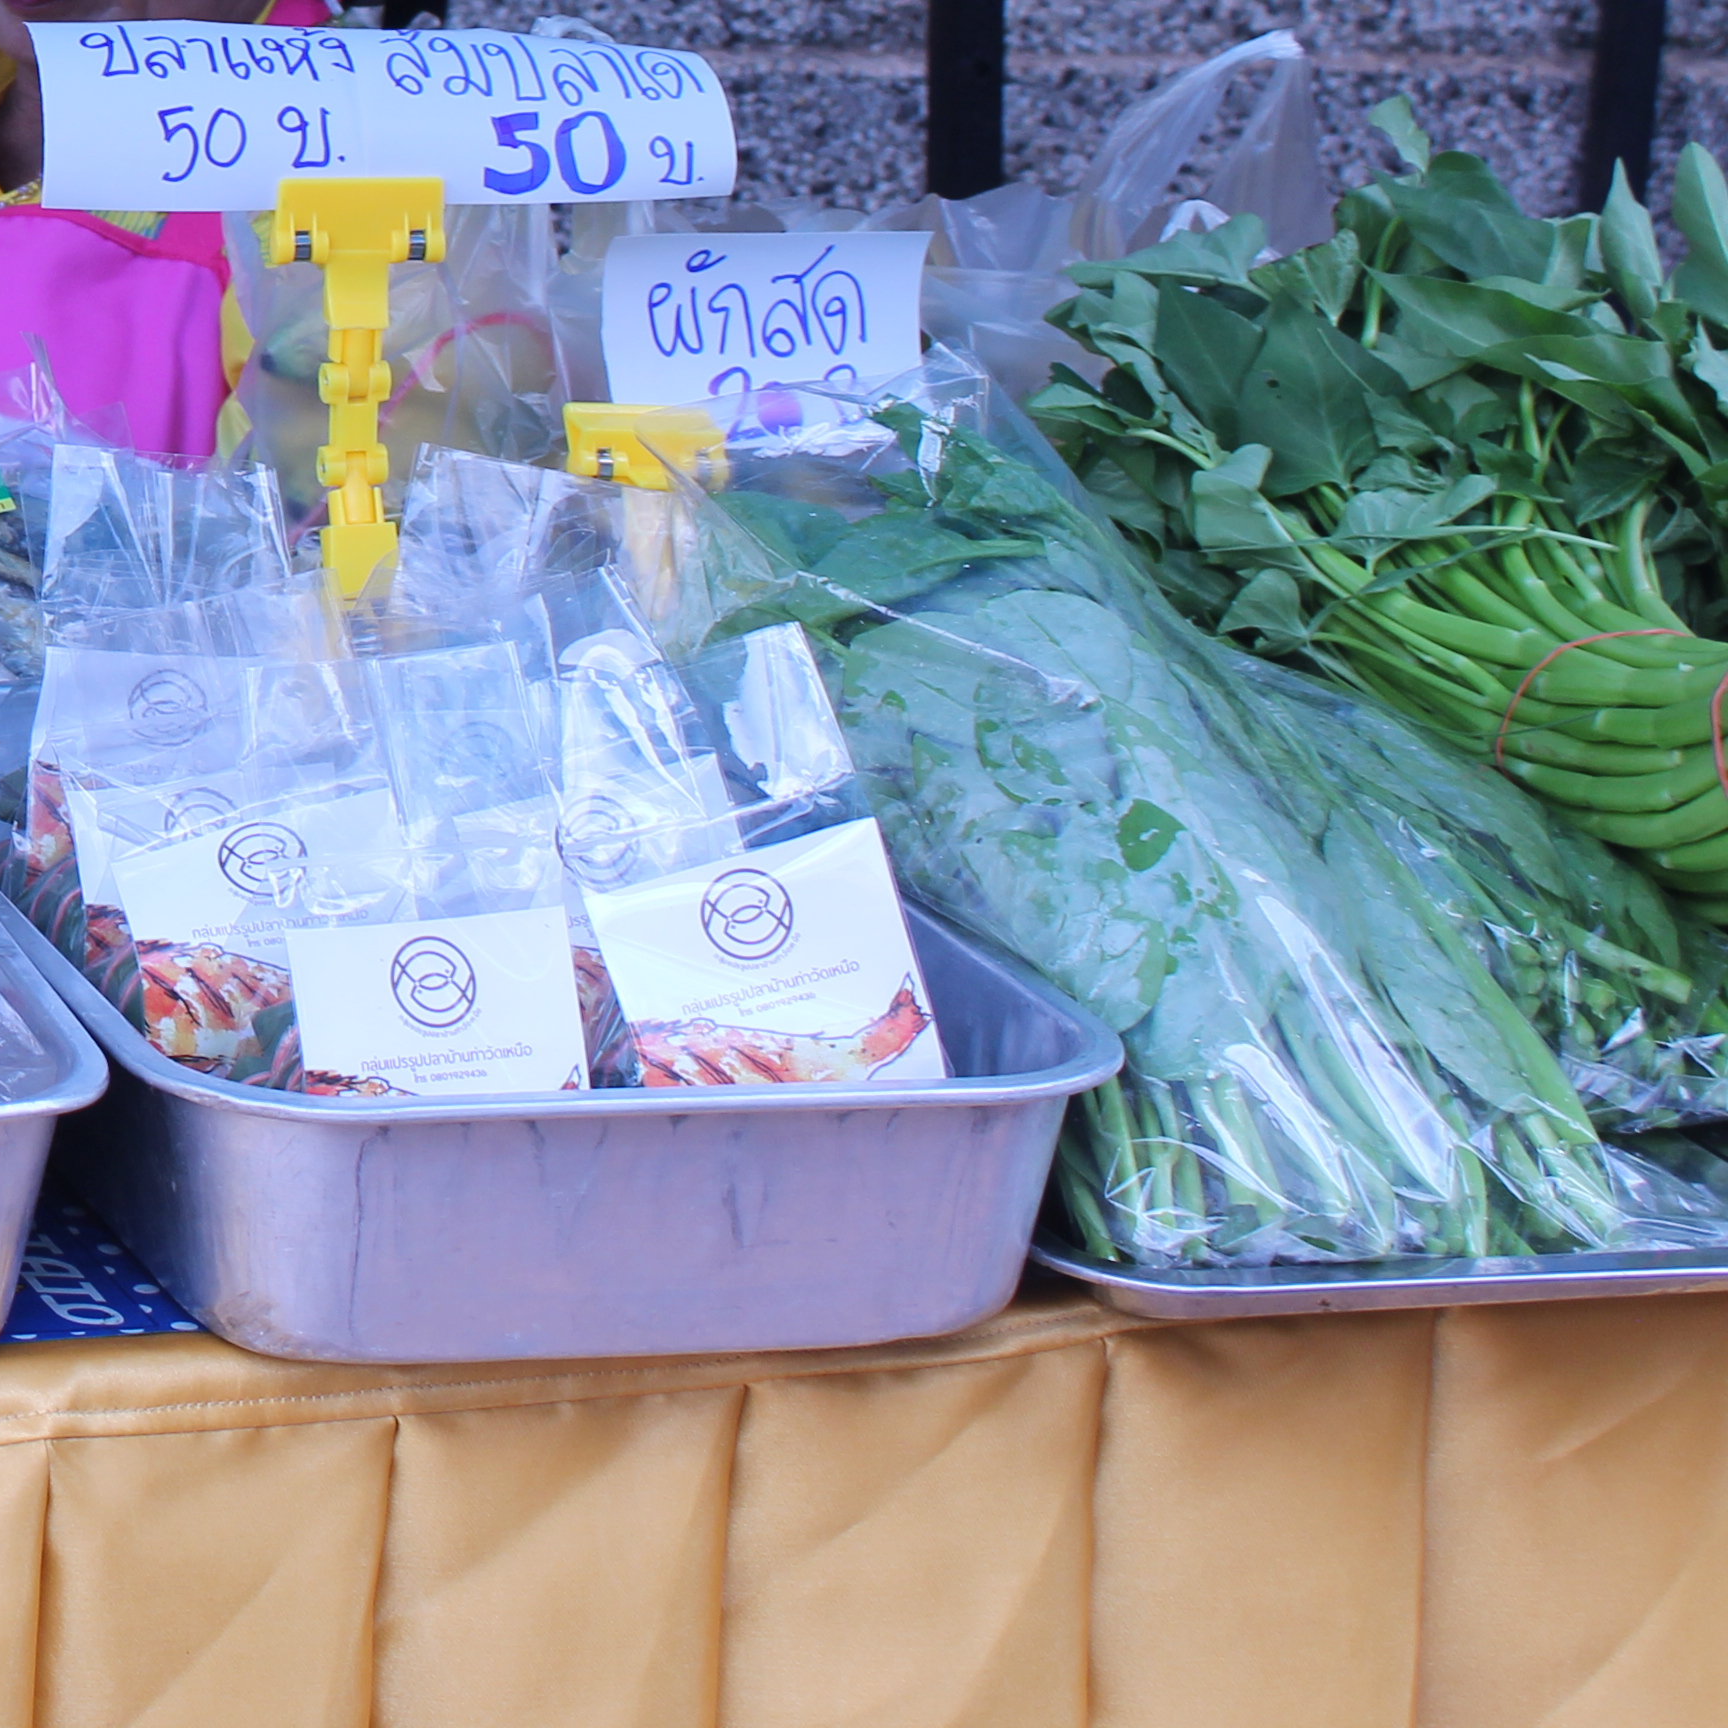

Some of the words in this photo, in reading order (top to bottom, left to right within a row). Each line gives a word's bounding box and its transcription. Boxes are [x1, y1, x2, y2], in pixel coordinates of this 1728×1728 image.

[155, 104, 248, 184] 50
[481, 109, 629, 197] 50
[647, 243, 868, 359] ผักสด
